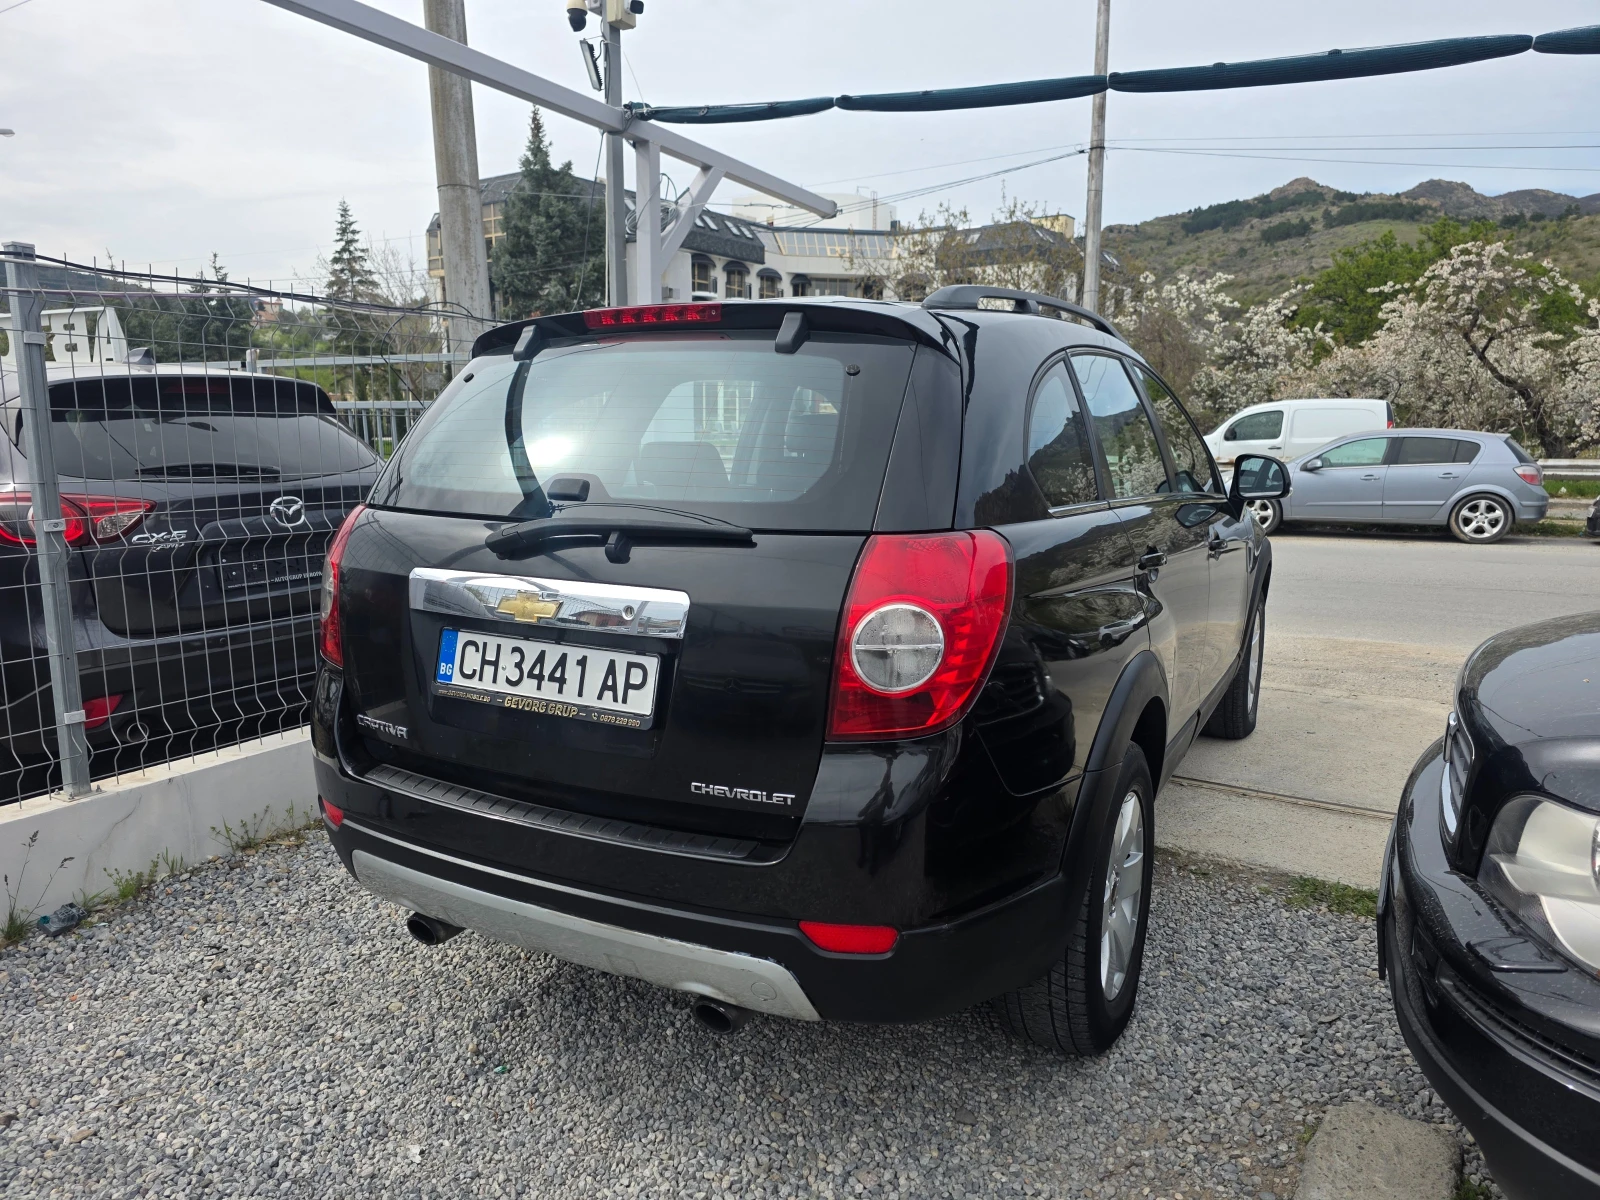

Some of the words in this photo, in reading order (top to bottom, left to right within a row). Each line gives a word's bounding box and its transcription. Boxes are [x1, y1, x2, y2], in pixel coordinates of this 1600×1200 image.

[131, 530, 188, 544] CX-5
[440, 662, 453, 676] BG
[597, 658, 648, 705] AP
[504, 695, 547, 713] GEVORG
[547, 702, 579, 718] GRUP
[356, 713, 409, 740] CAPTIVA
[690, 781, 796, 806] CHEVROLET
